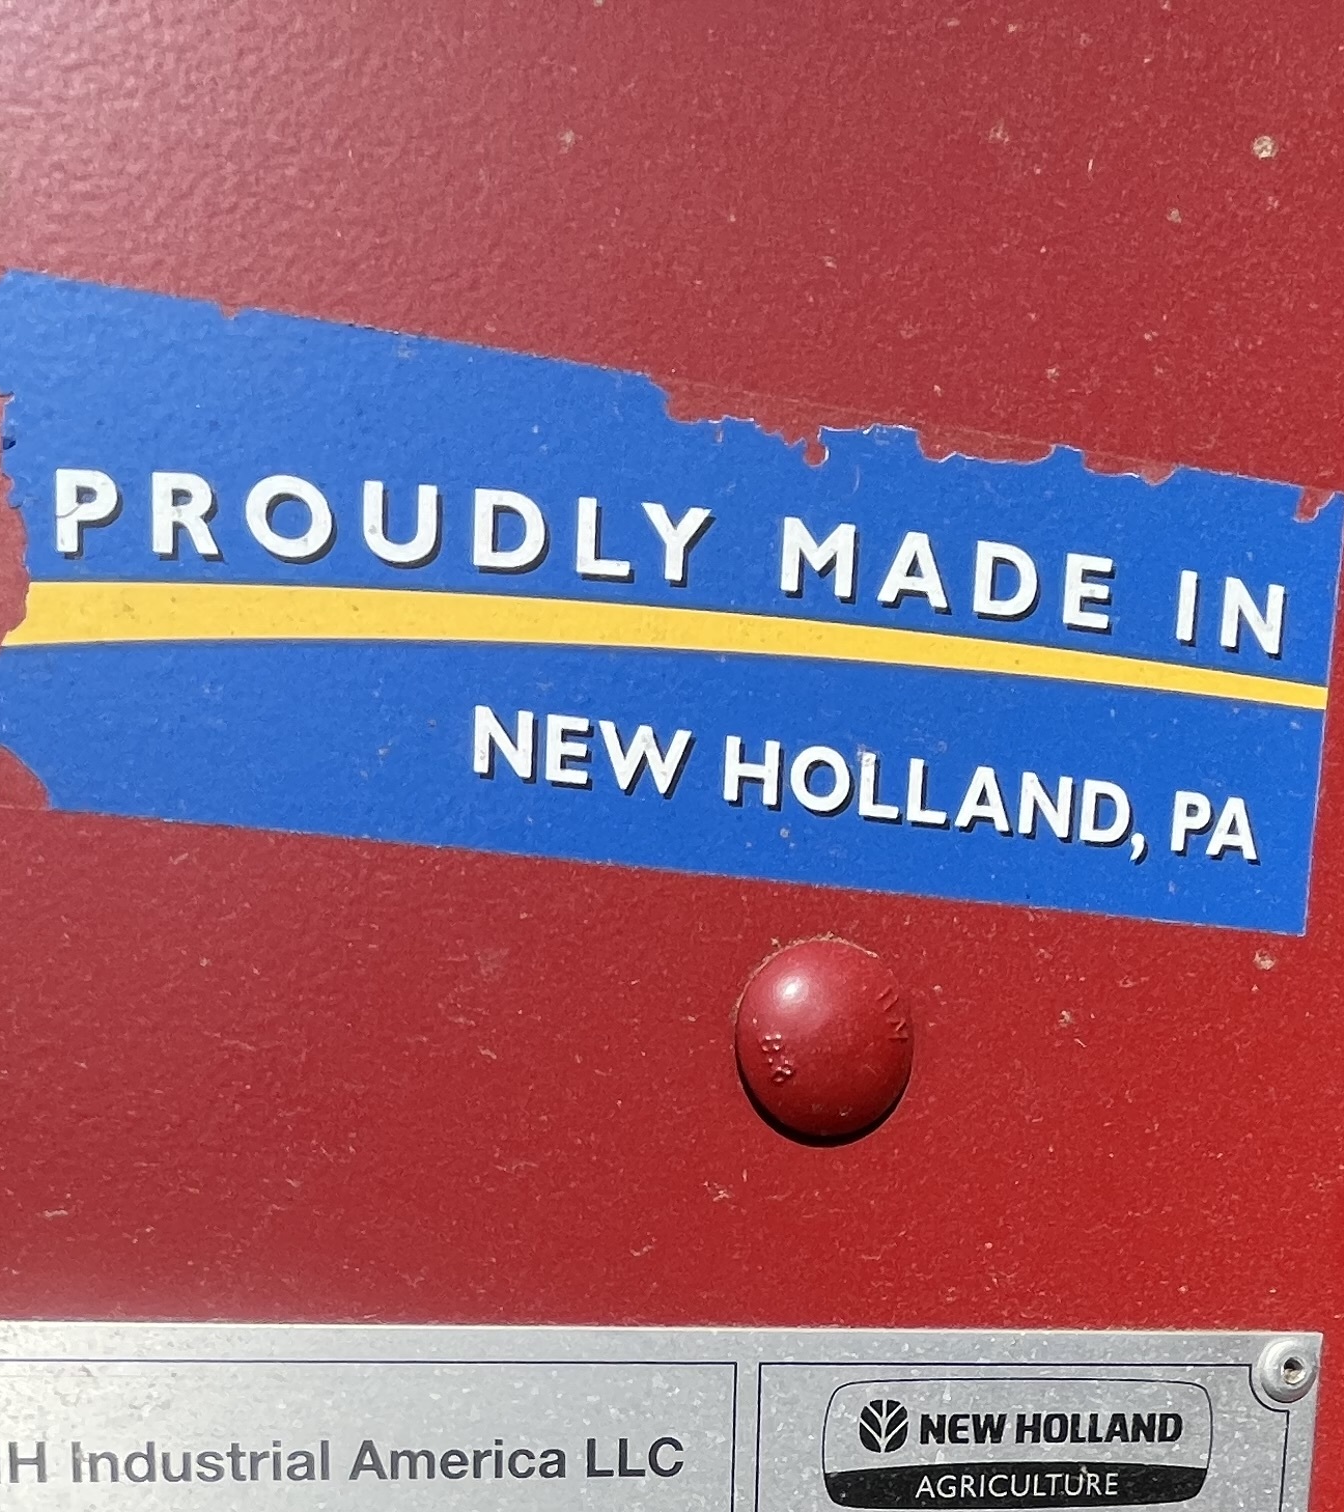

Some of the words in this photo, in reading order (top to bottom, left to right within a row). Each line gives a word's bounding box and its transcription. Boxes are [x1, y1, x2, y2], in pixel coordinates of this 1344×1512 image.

[56, 469, 712, 586] PROUDLY
[779, 517, 1113, 633] MADE
[1176, 568, 1285, 656] IN
[471, 706, 692, 796] NEW
[723, 735, 1145, 863] HOLLAND,
[1171, 790, 1258, 862] PA
[919, 1412, 1013, 1445] NEW
[1015, 1412, 1182, 1444] HOLLAND
[71, 1440, 329, 1482] Industrial
[349, 1439, 566, 1480] America
[586, 1437, 684, 1478] LLC
[915, 1472, 1119, 1498] AGRICULTURE
